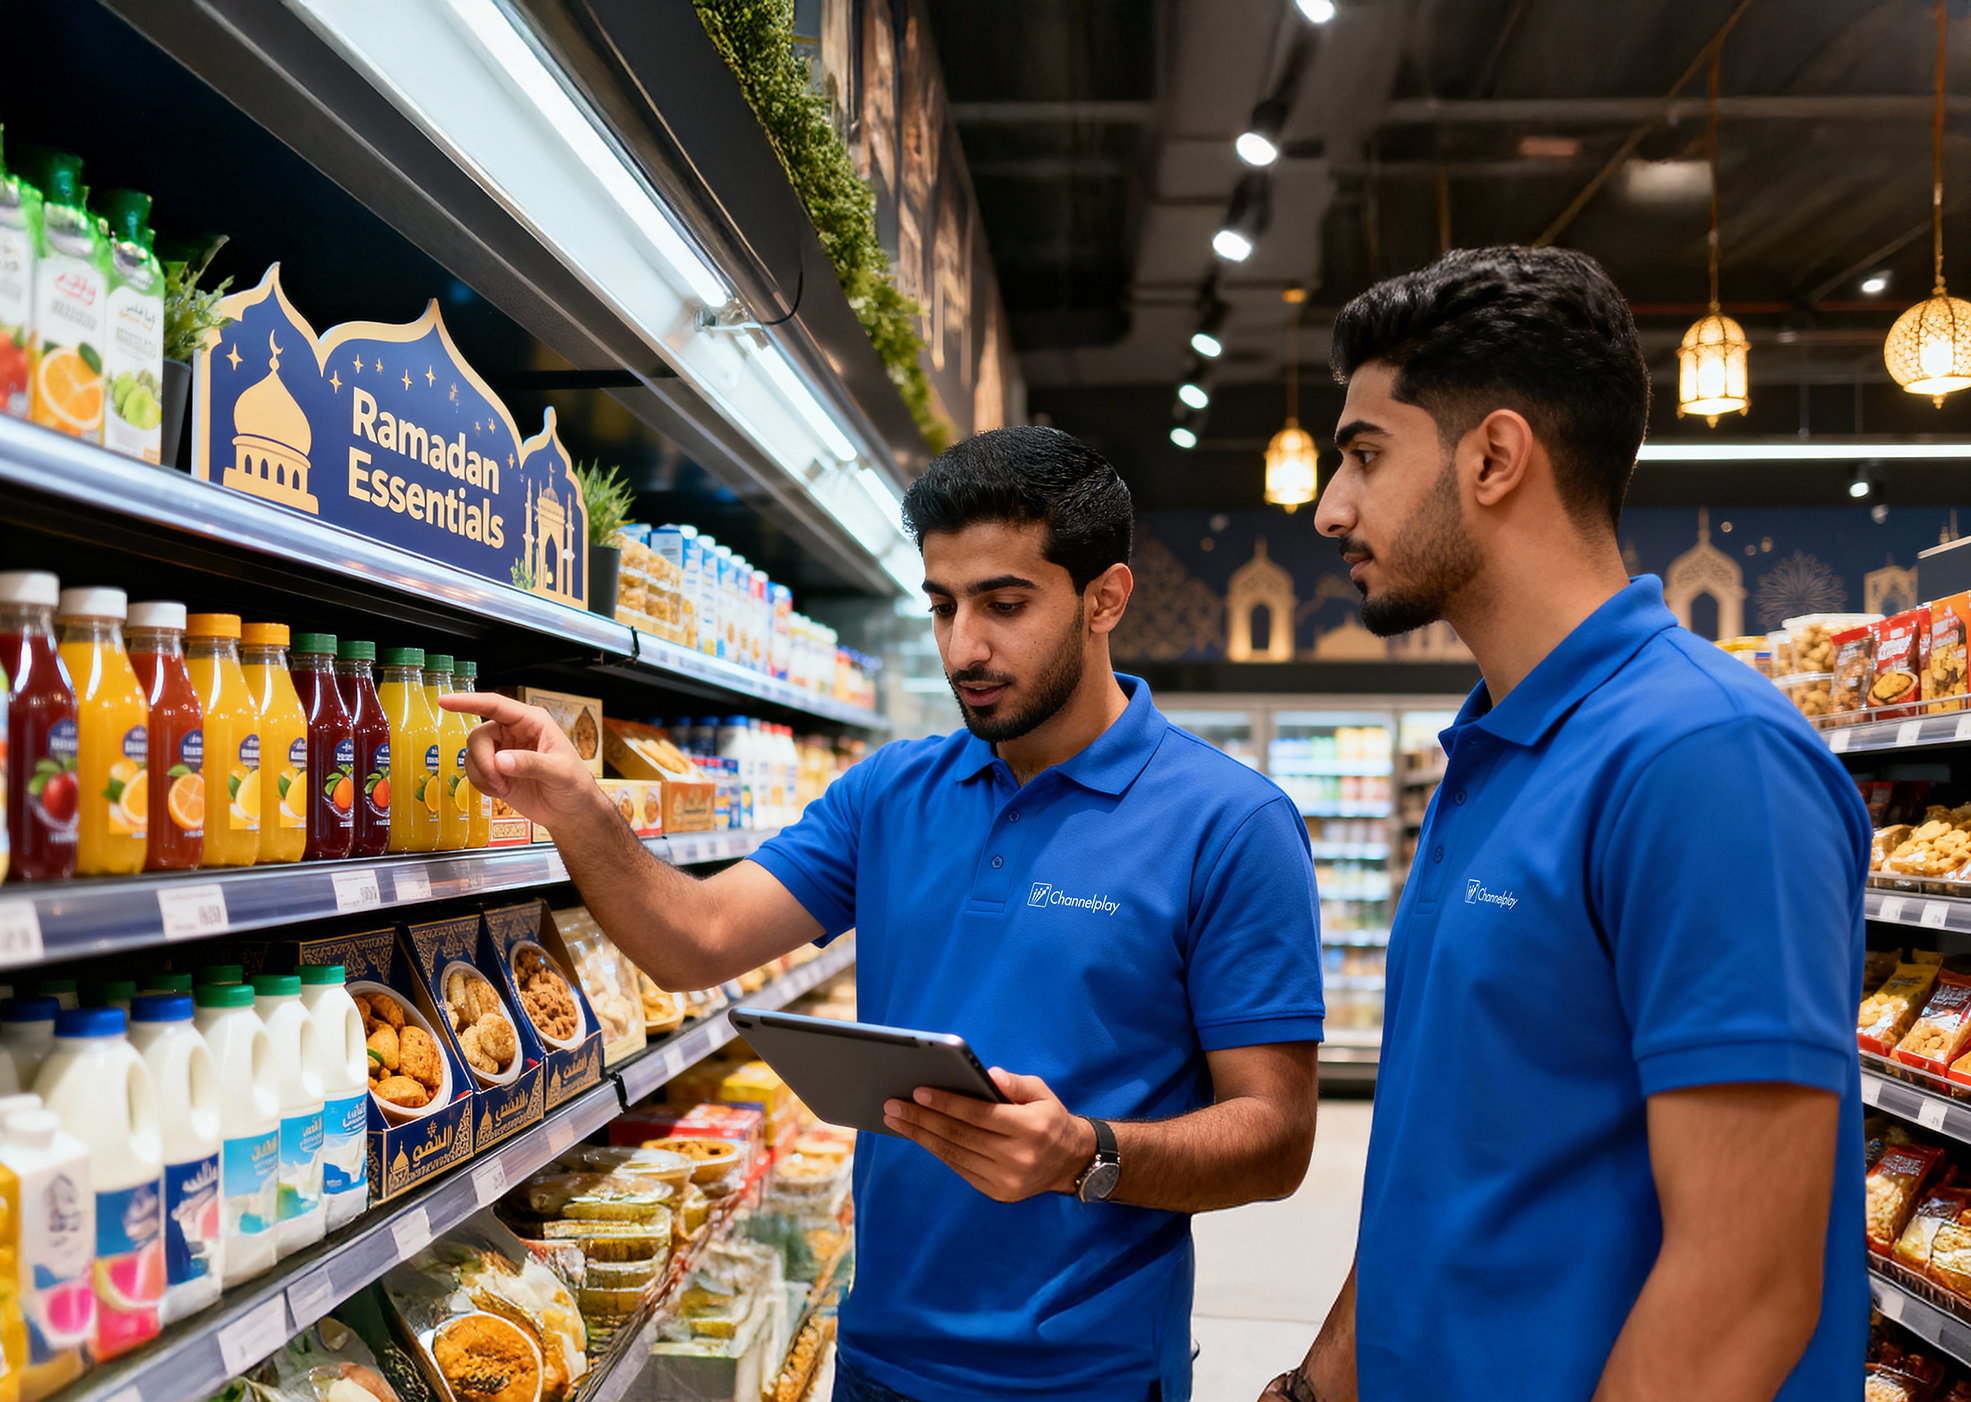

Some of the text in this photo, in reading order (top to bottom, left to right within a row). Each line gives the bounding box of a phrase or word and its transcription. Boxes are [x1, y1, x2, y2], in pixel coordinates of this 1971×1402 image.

[352, 386, 500, 495] Ramadan
[348, 446, 505, 549] Essentials
[1050, 889, 1121, 916] Channelplay
